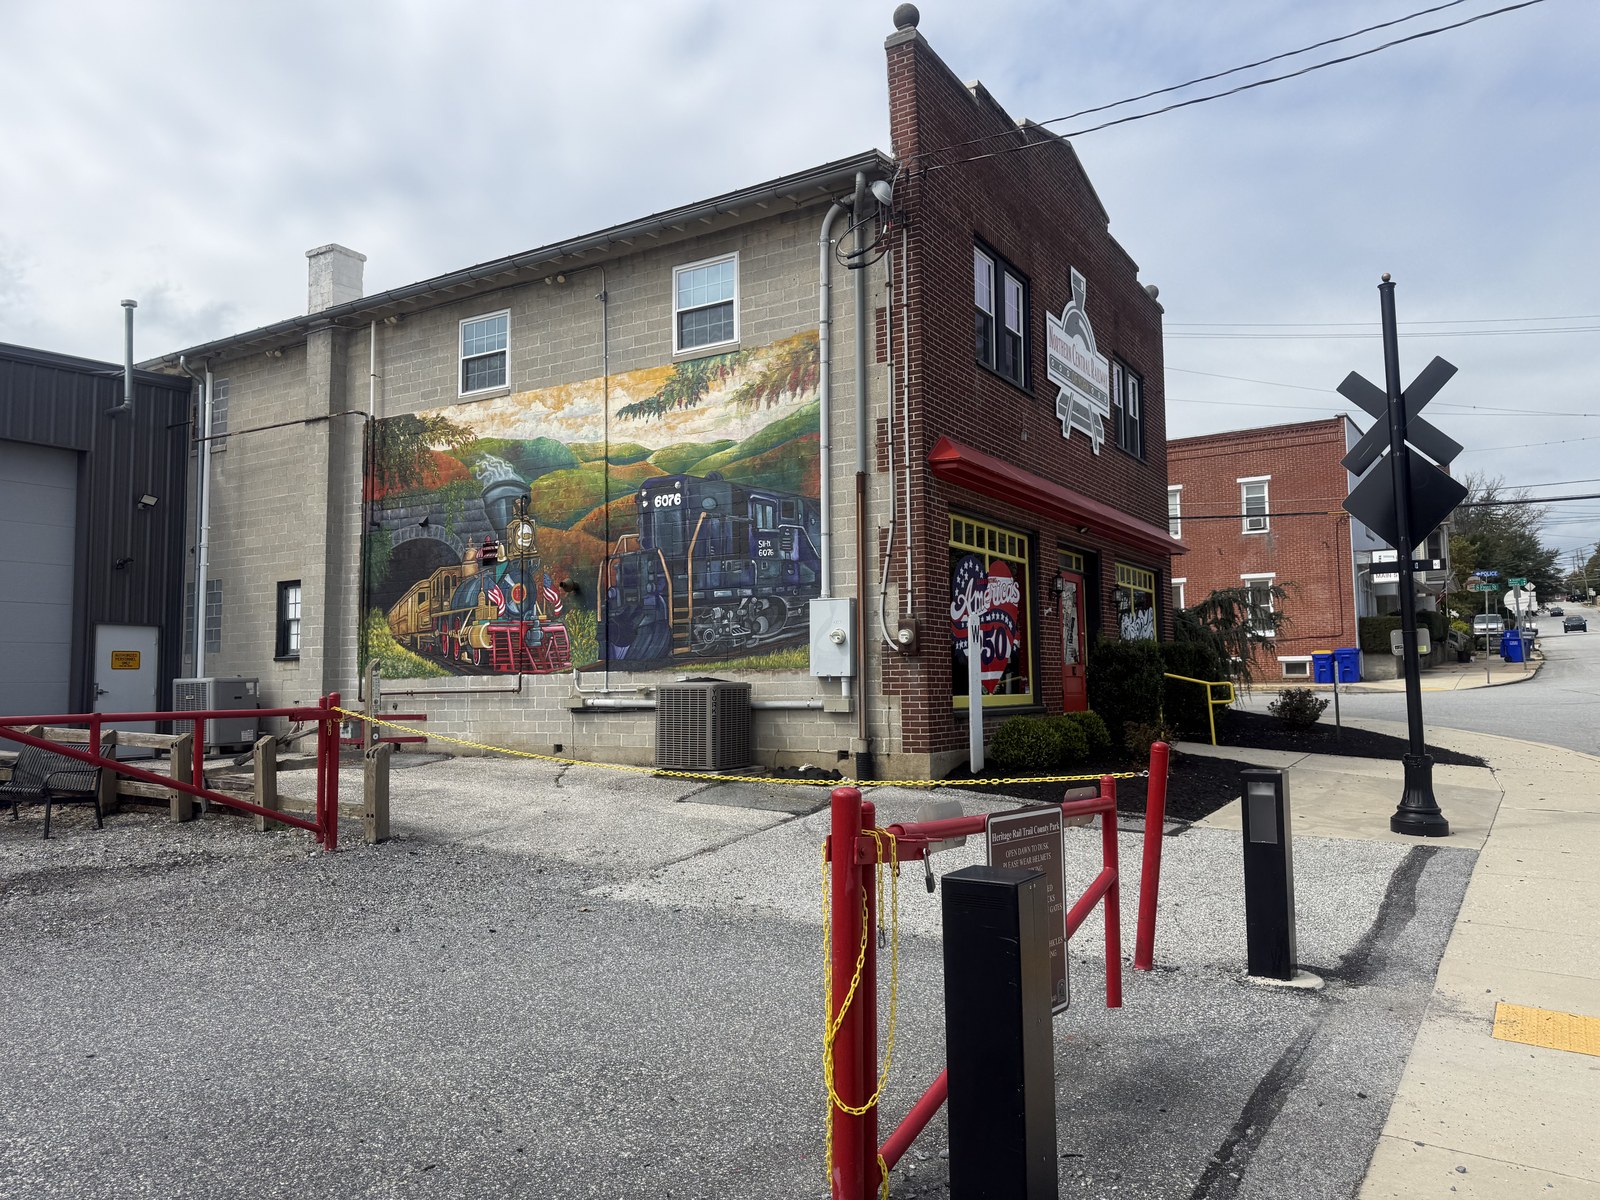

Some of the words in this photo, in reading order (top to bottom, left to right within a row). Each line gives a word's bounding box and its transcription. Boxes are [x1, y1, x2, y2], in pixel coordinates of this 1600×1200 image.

[1049, 325, 1072, 363] NORTHERN
[1072, 343, 1090, 377] CENTRAL
[1091, 357, 1107, 389] RAILWAY
[654, 493, 682, 508] 6076
[758, 549, 774, 557] 6076
[971, 625, 980, 643] W
[979, 627, 1008, 665] 50
[992, 831, 1012, 843] Heritage
[1012, 828, 1022, 839] Rail
[1022, 825, 1034, 836] Trail
[1034, 824, 1049, 835] County
[1049, 821, 1060, 831] Park
[1005, 848, 1018, 859] OPEN
[1018, 845, 1031, 856] DAWN
[1031, 844, 1038, 852] TO
[1038, 842, 1049, 850] DUSK
[1003, 859, 1019, 868] PLEASE
[1020, 856, 1032, 865] WEAR
[1032, 852, 1052, 863] HELMETS
[1050, 903, 1063, 912] GATES
[1049, 936, 1063, 947] HICLES
